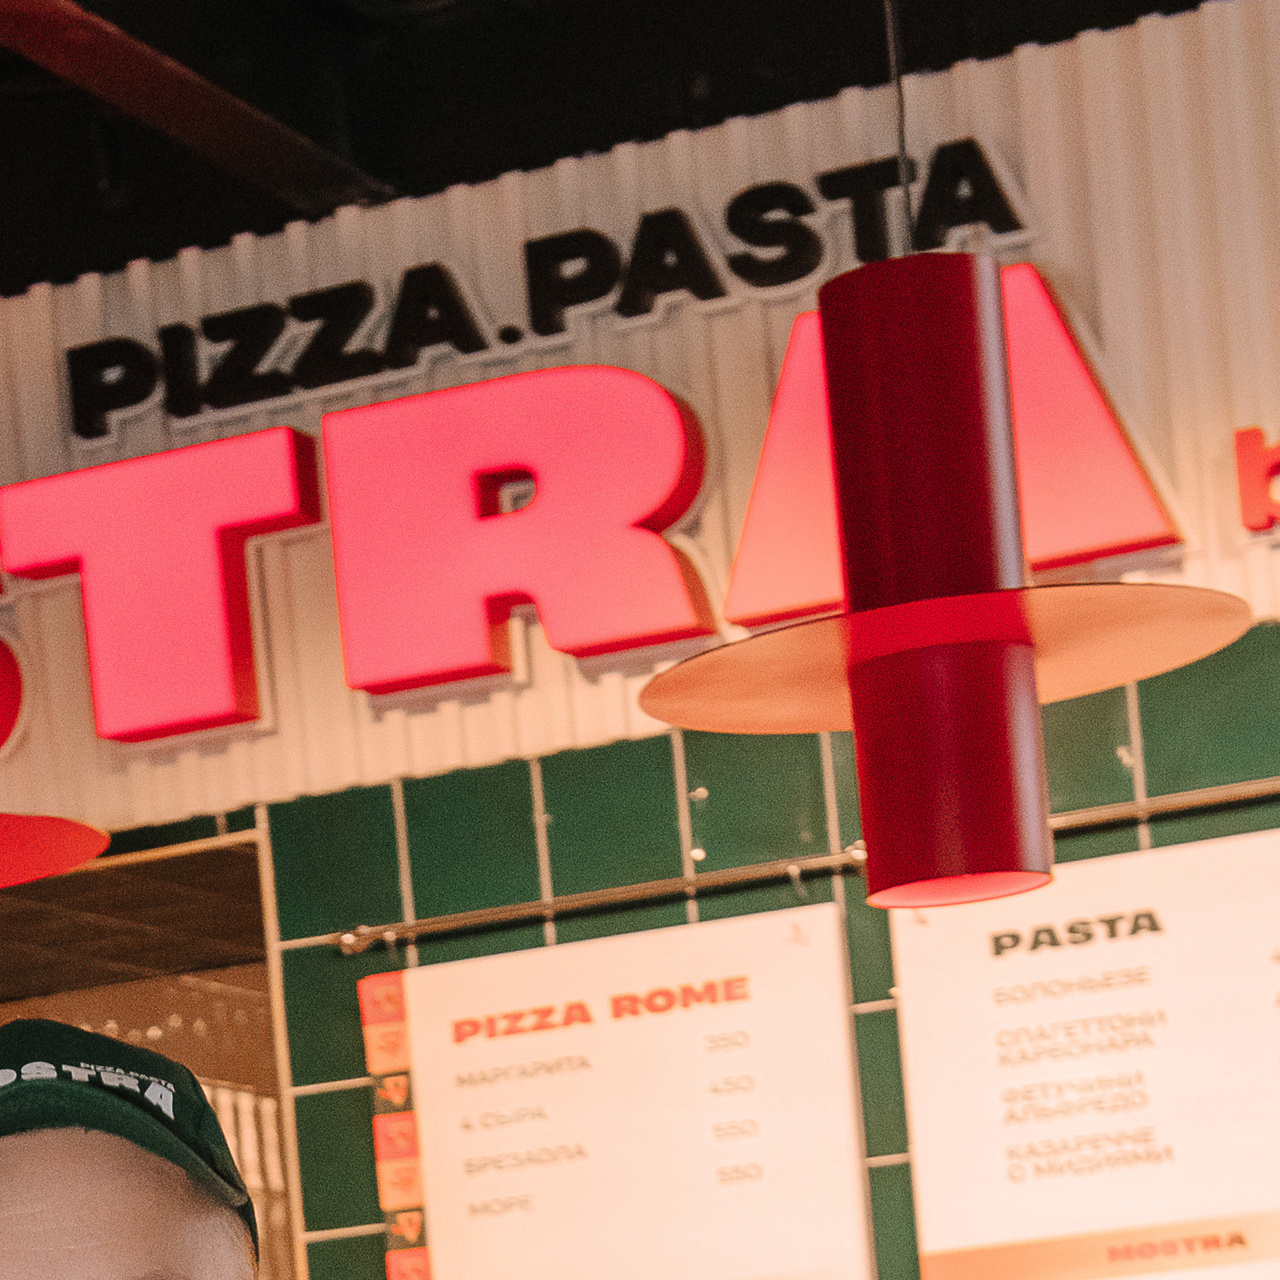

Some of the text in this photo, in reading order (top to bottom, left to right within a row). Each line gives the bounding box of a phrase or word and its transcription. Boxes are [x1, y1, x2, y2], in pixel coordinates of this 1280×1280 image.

[991, 910, 1163, 957] PASTA
[452, 976, 749, 1044] PIZZA ROME
[455, 1055, 592, 1088] МАРГАРИТА
[1107, 1231, 1247, 1262] MOSTRA
